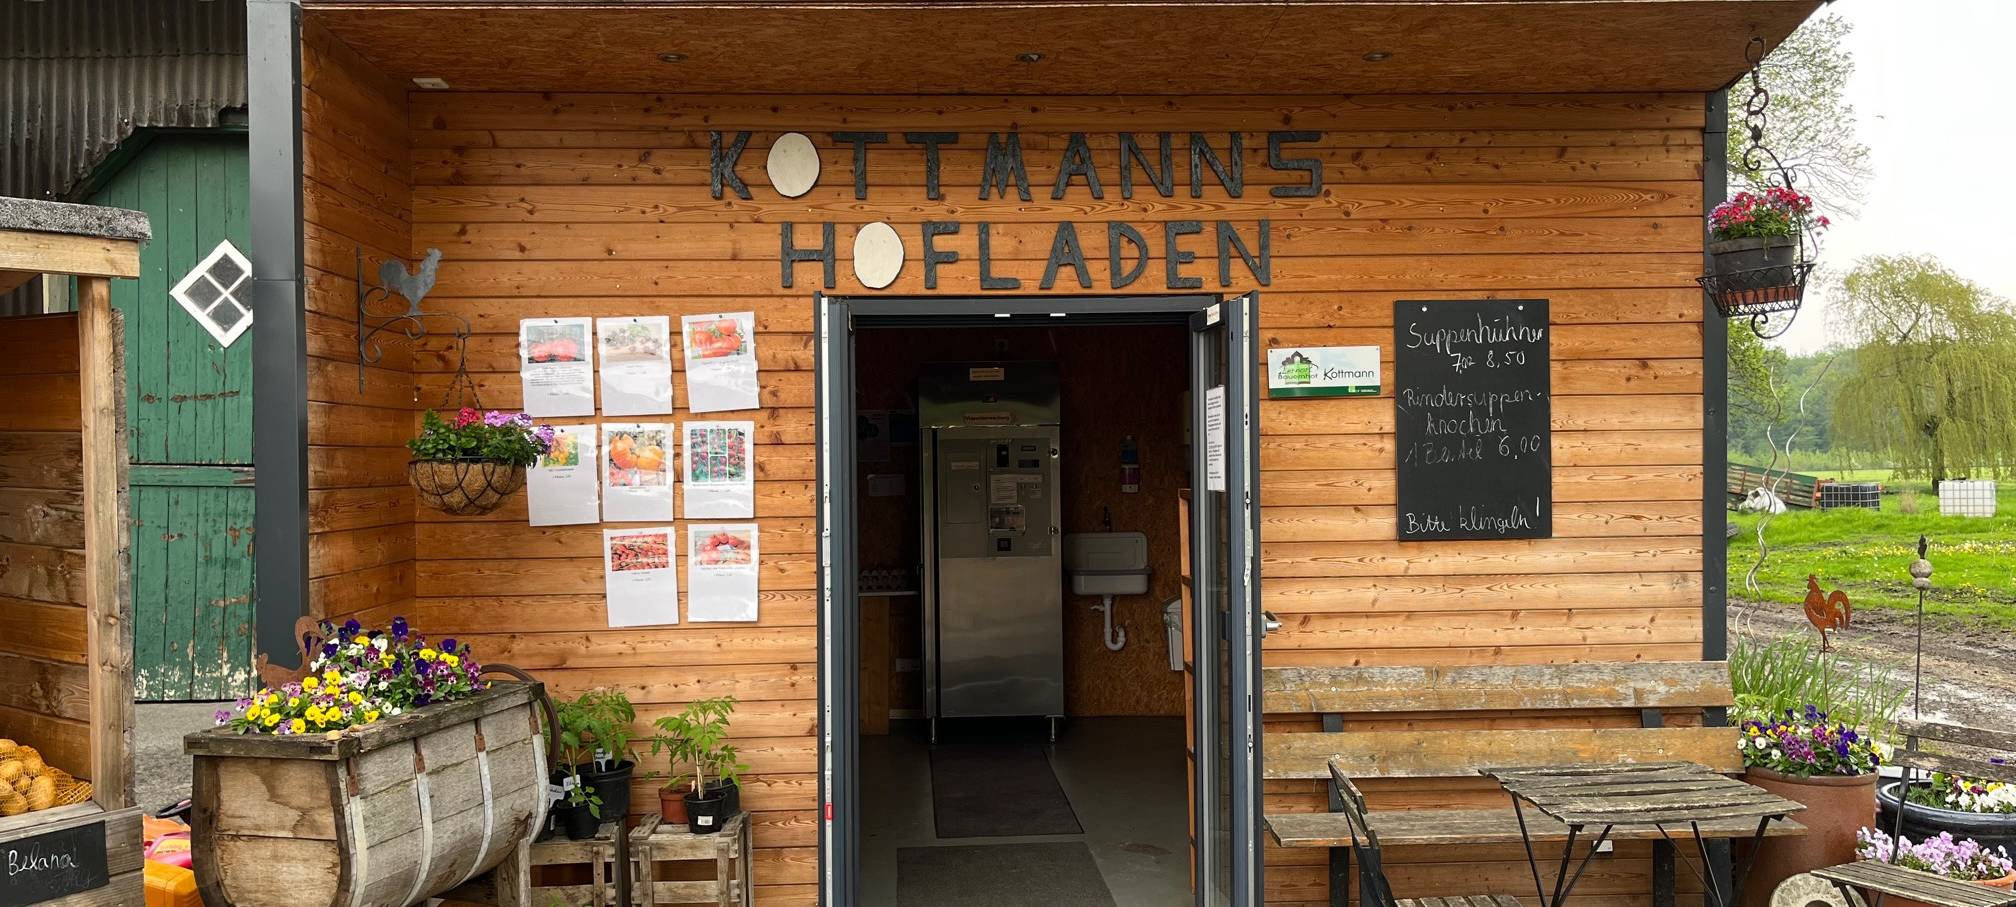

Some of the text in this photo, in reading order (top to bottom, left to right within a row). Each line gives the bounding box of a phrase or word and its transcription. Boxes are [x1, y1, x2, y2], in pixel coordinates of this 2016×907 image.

[709, 130, 1323, 200] KOTTMANNS
[780, 219, 1272, 289] HOFLADEN
[1486, 350, 1525, 369] 8,50
[1323, 367, 1374, 380] Kottmann
[1406, 512, 1450, 535] Bitte
